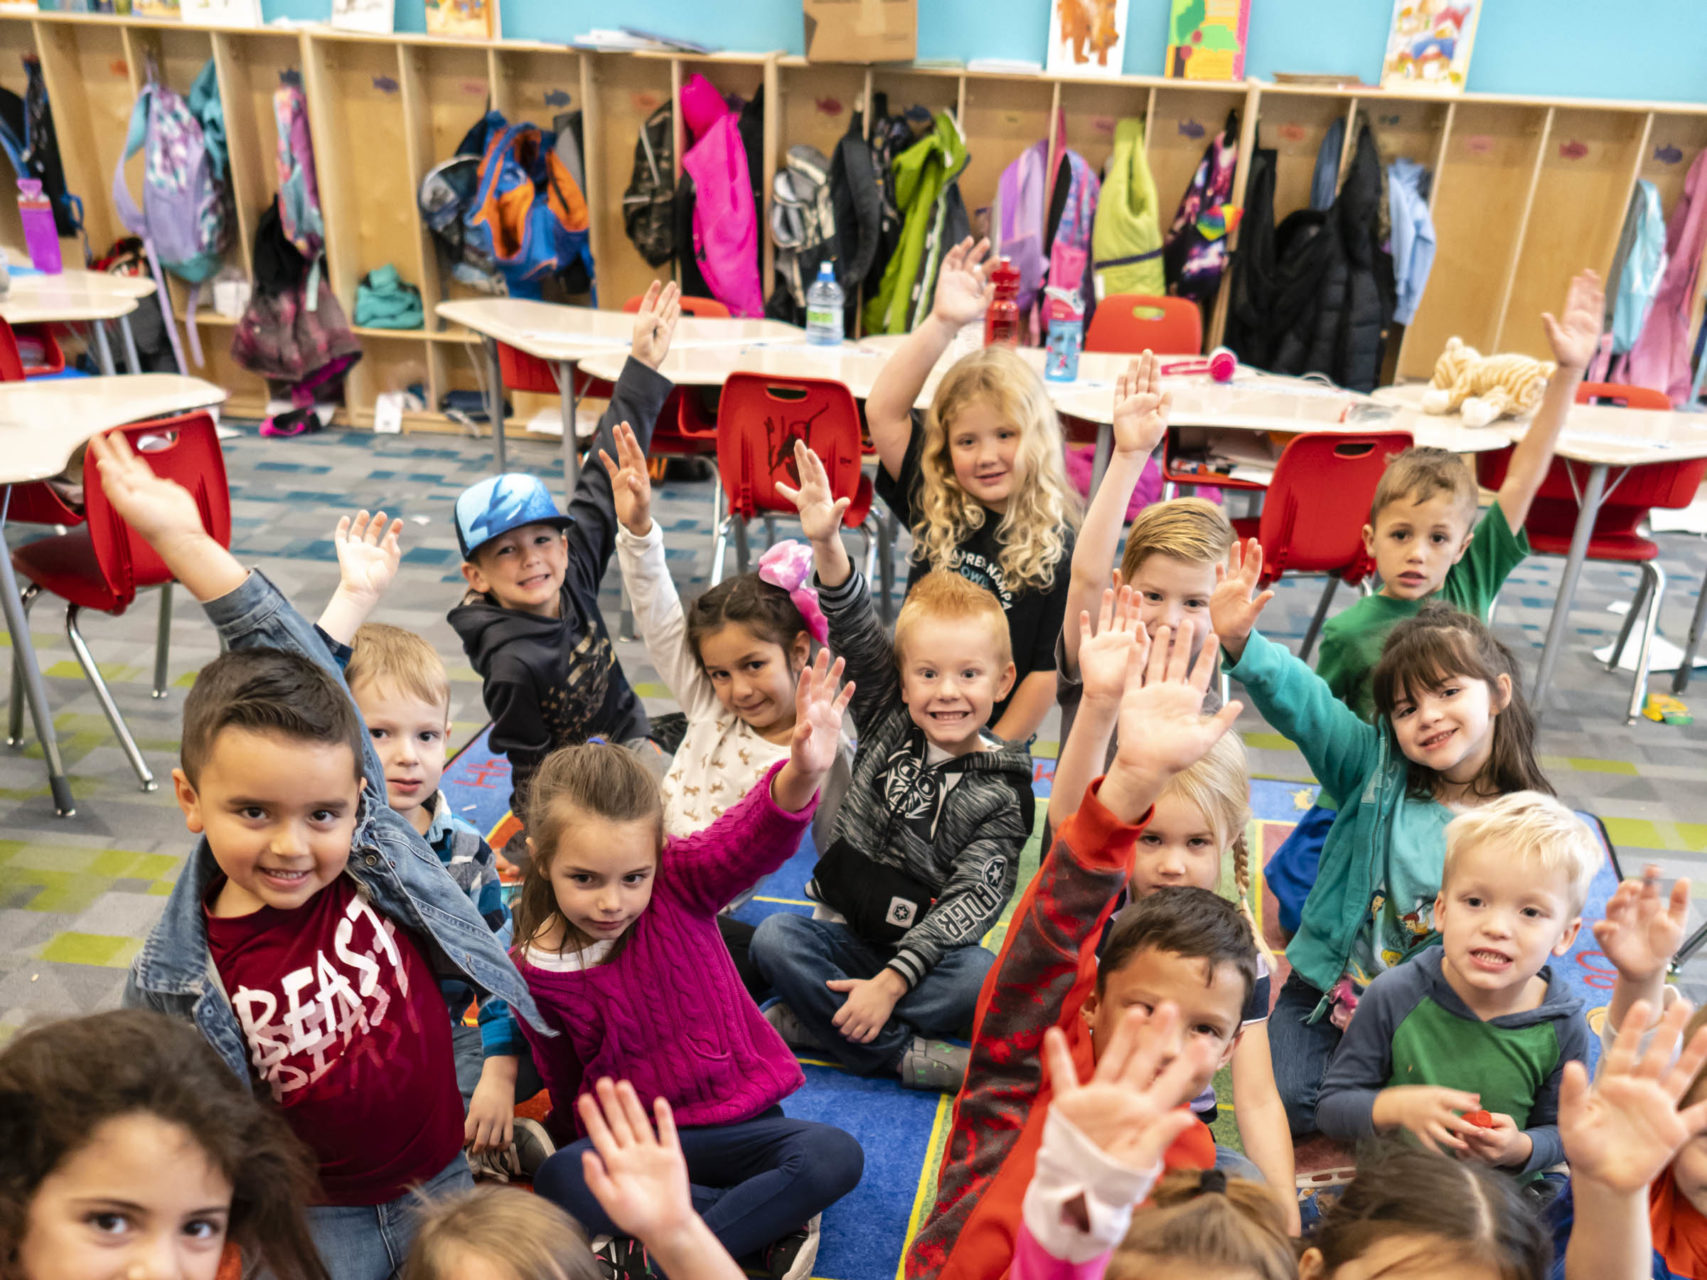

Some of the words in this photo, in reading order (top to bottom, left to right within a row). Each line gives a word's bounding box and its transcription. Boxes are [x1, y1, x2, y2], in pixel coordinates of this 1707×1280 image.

[986, 562, 1013, 610] NAMPA
[453, 758, 511, 789] Hh
[232, 894, 398, 1068] BEAST
